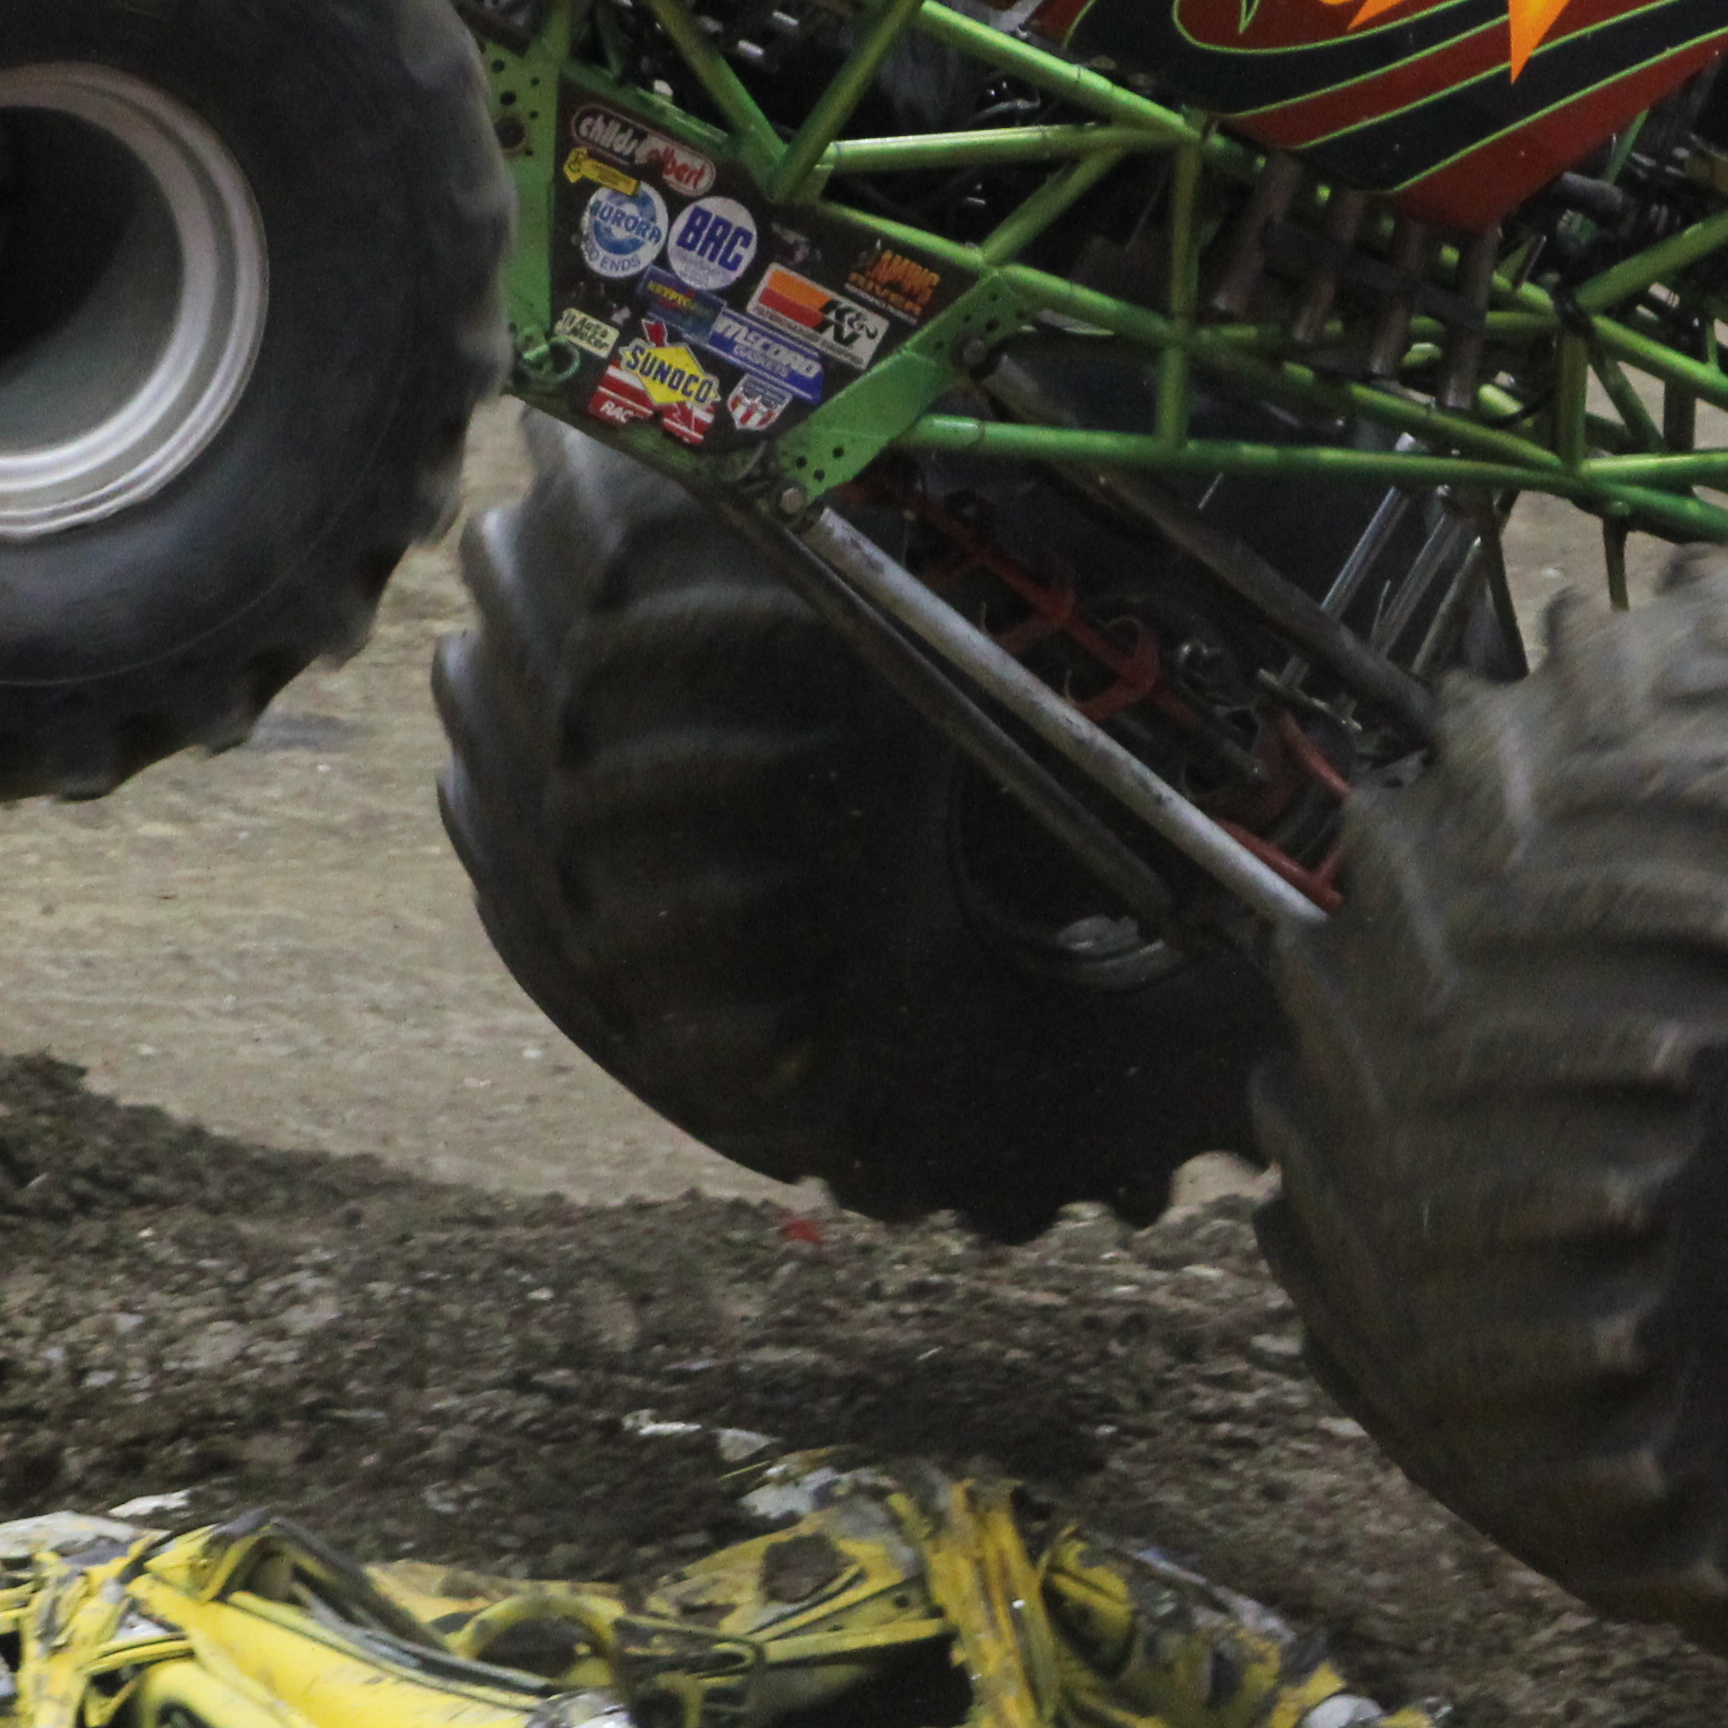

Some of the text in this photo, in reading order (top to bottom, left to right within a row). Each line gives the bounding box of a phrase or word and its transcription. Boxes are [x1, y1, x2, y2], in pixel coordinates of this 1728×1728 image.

[590, 201, 663, 245] AURORA
[676, 205, 754, 272] BRC
[625, 344, 714, 404] SUNOCO
[600, 400, 640, 424] RAC
